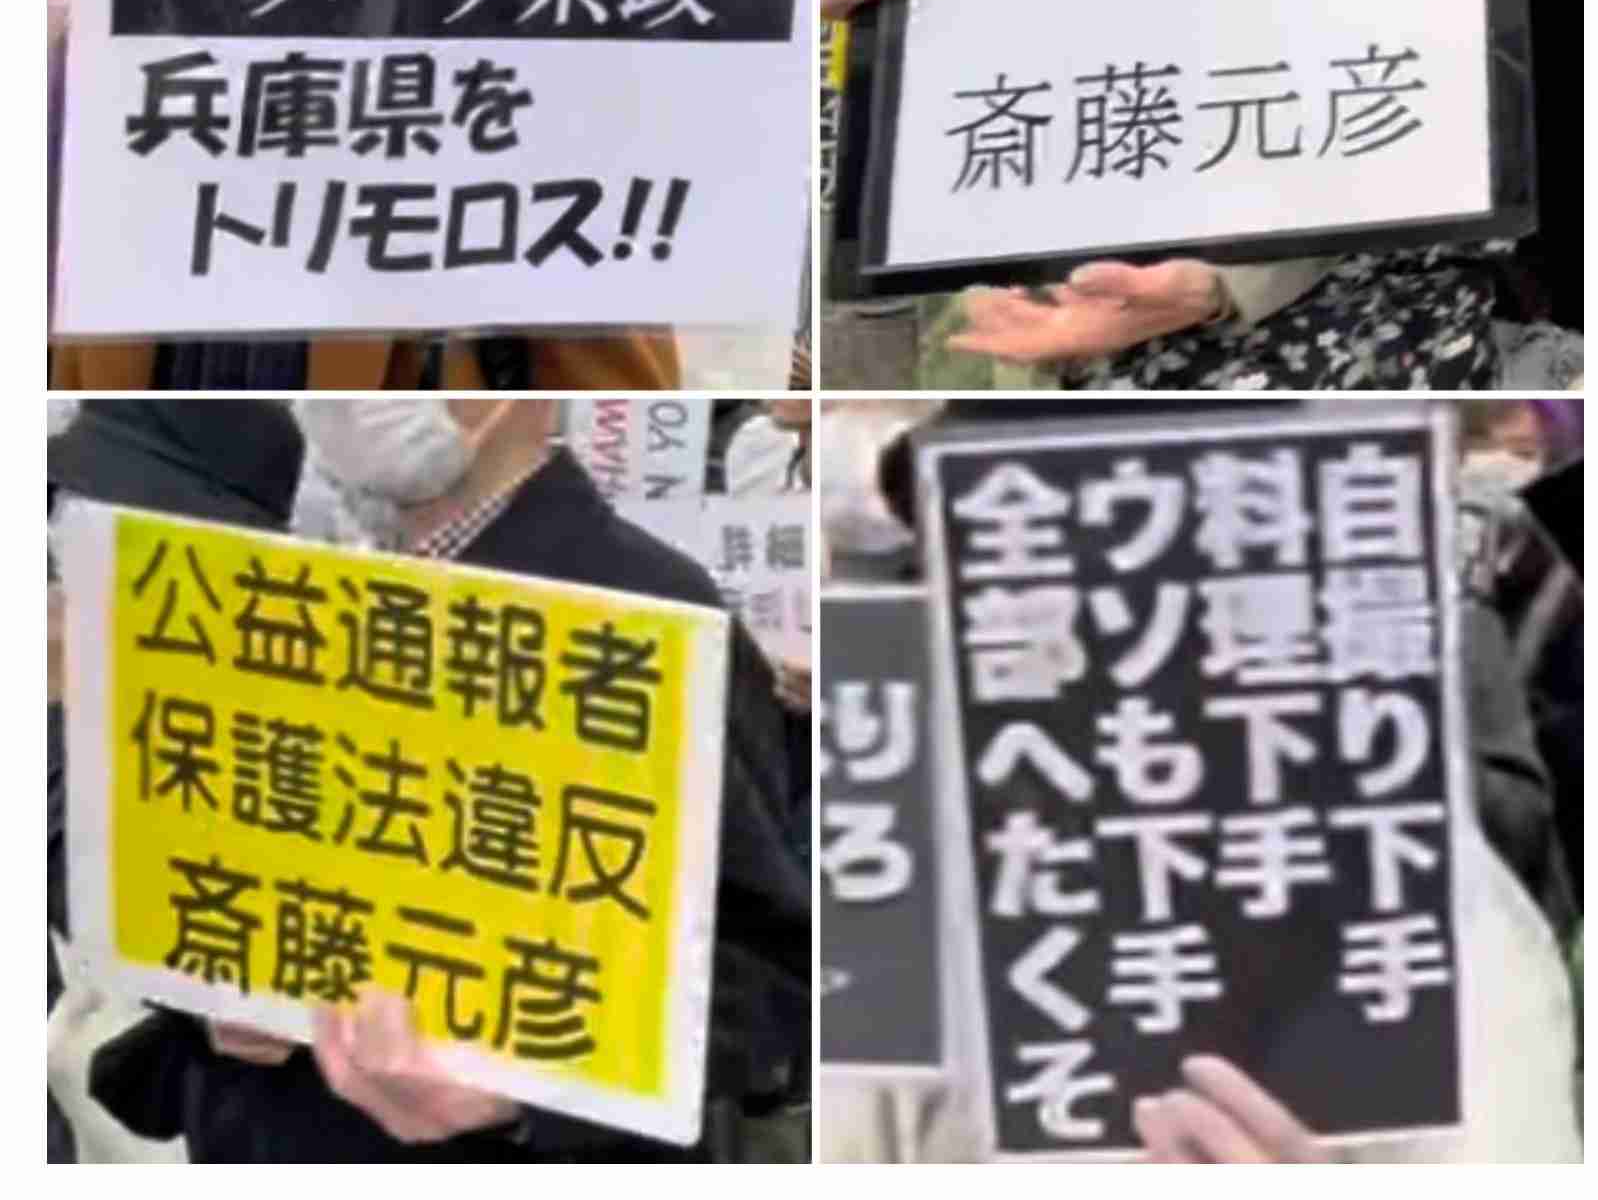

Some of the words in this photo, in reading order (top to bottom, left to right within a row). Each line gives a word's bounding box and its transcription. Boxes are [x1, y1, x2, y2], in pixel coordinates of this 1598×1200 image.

[125, 51, 534, 159] 兵庫県を
[946, 44, 1427, 195] 斎藤元彦
[189, 176, 692, 276] トリモロス!!
[131, 538, 665, 756] 公益通報者
[820, 680, 916, 782] り
[1078, 458, 1222, 1033] ウソも下手
[1191, 449, 1332, 921] 料理下手
[1316, 444, 1453, 1025] 自撮り下手
[130, 690, 657, 923] 保護法違反
[952, 461, 1117, 1140] 全部へたくそ
[164, 854, 602, 1062] 斎藤元彦
